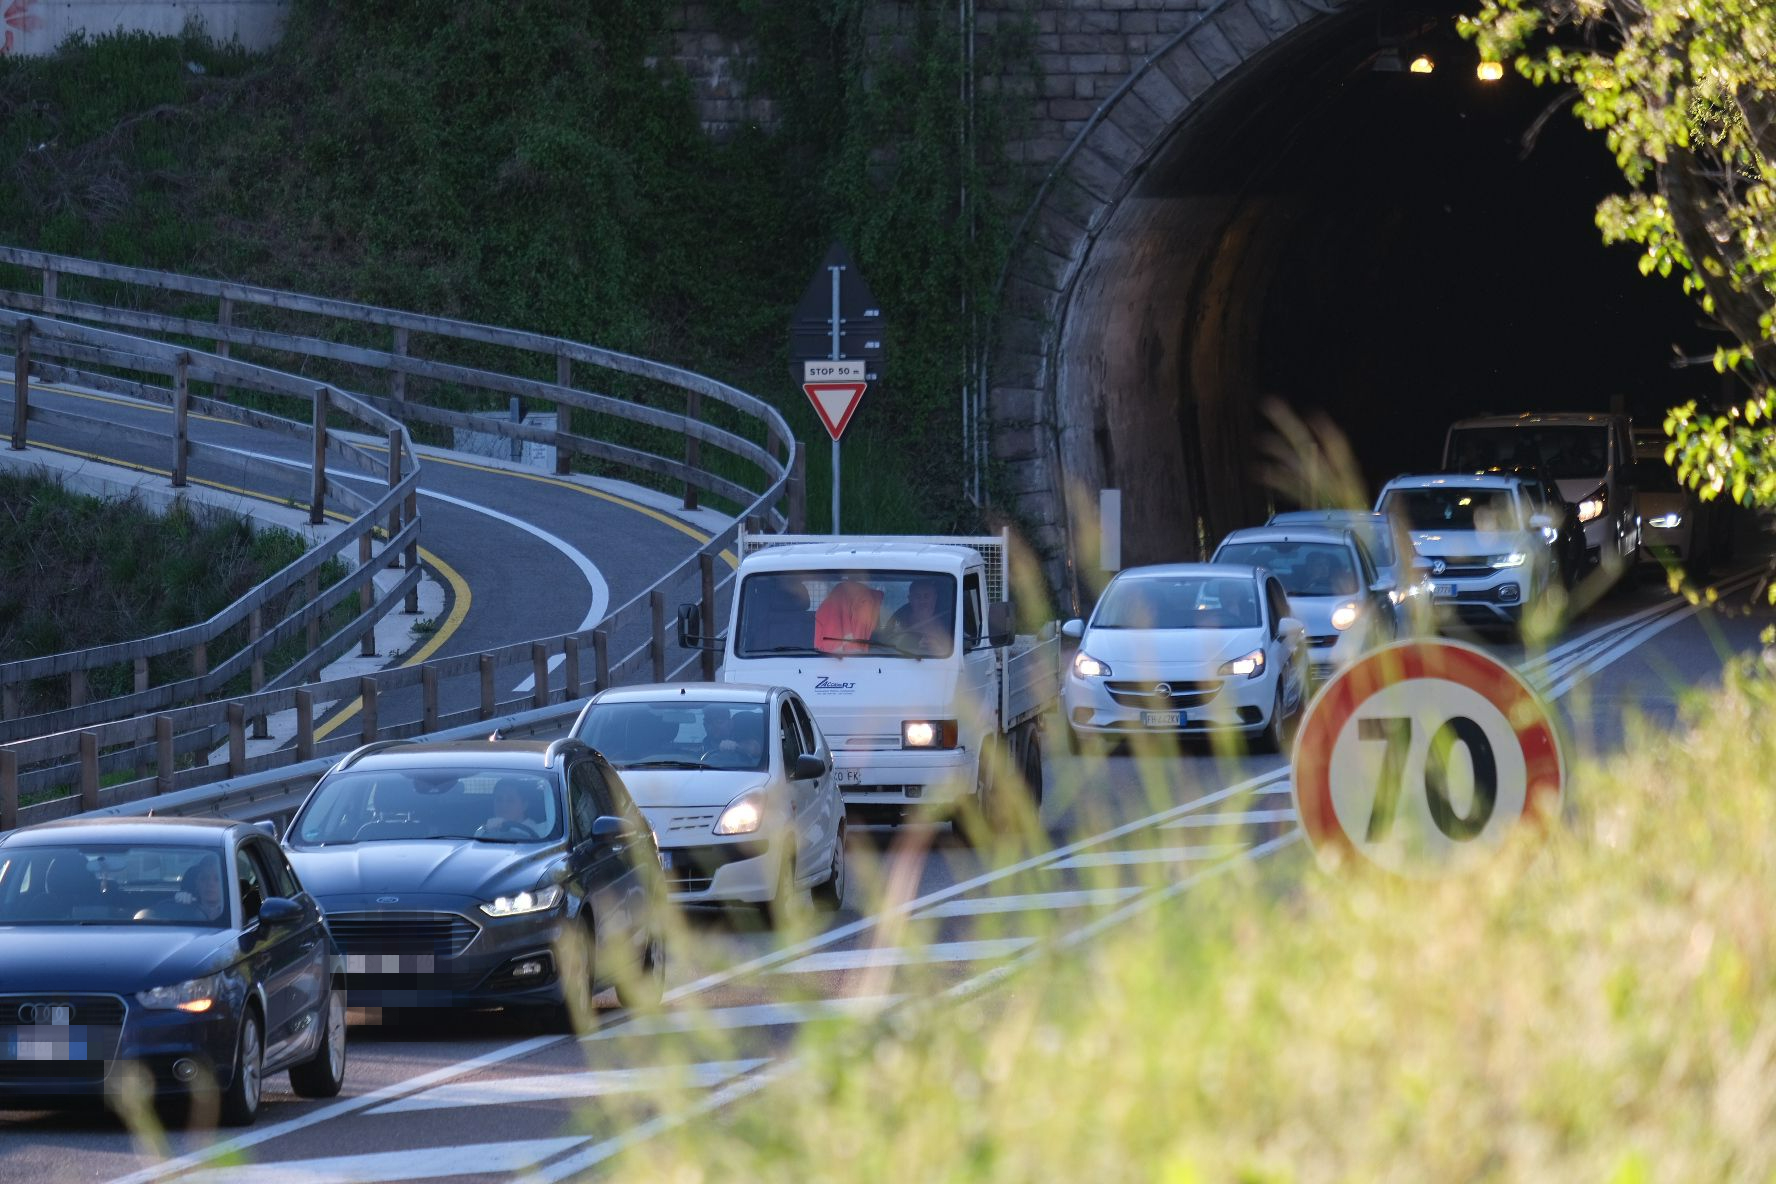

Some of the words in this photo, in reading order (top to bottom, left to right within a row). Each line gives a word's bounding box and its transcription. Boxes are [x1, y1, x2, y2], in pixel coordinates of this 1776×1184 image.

[809, 368, 834, 376] STOP
[838, 367, 850, 375] 50
[1357, 716, 1497, 843] 70
